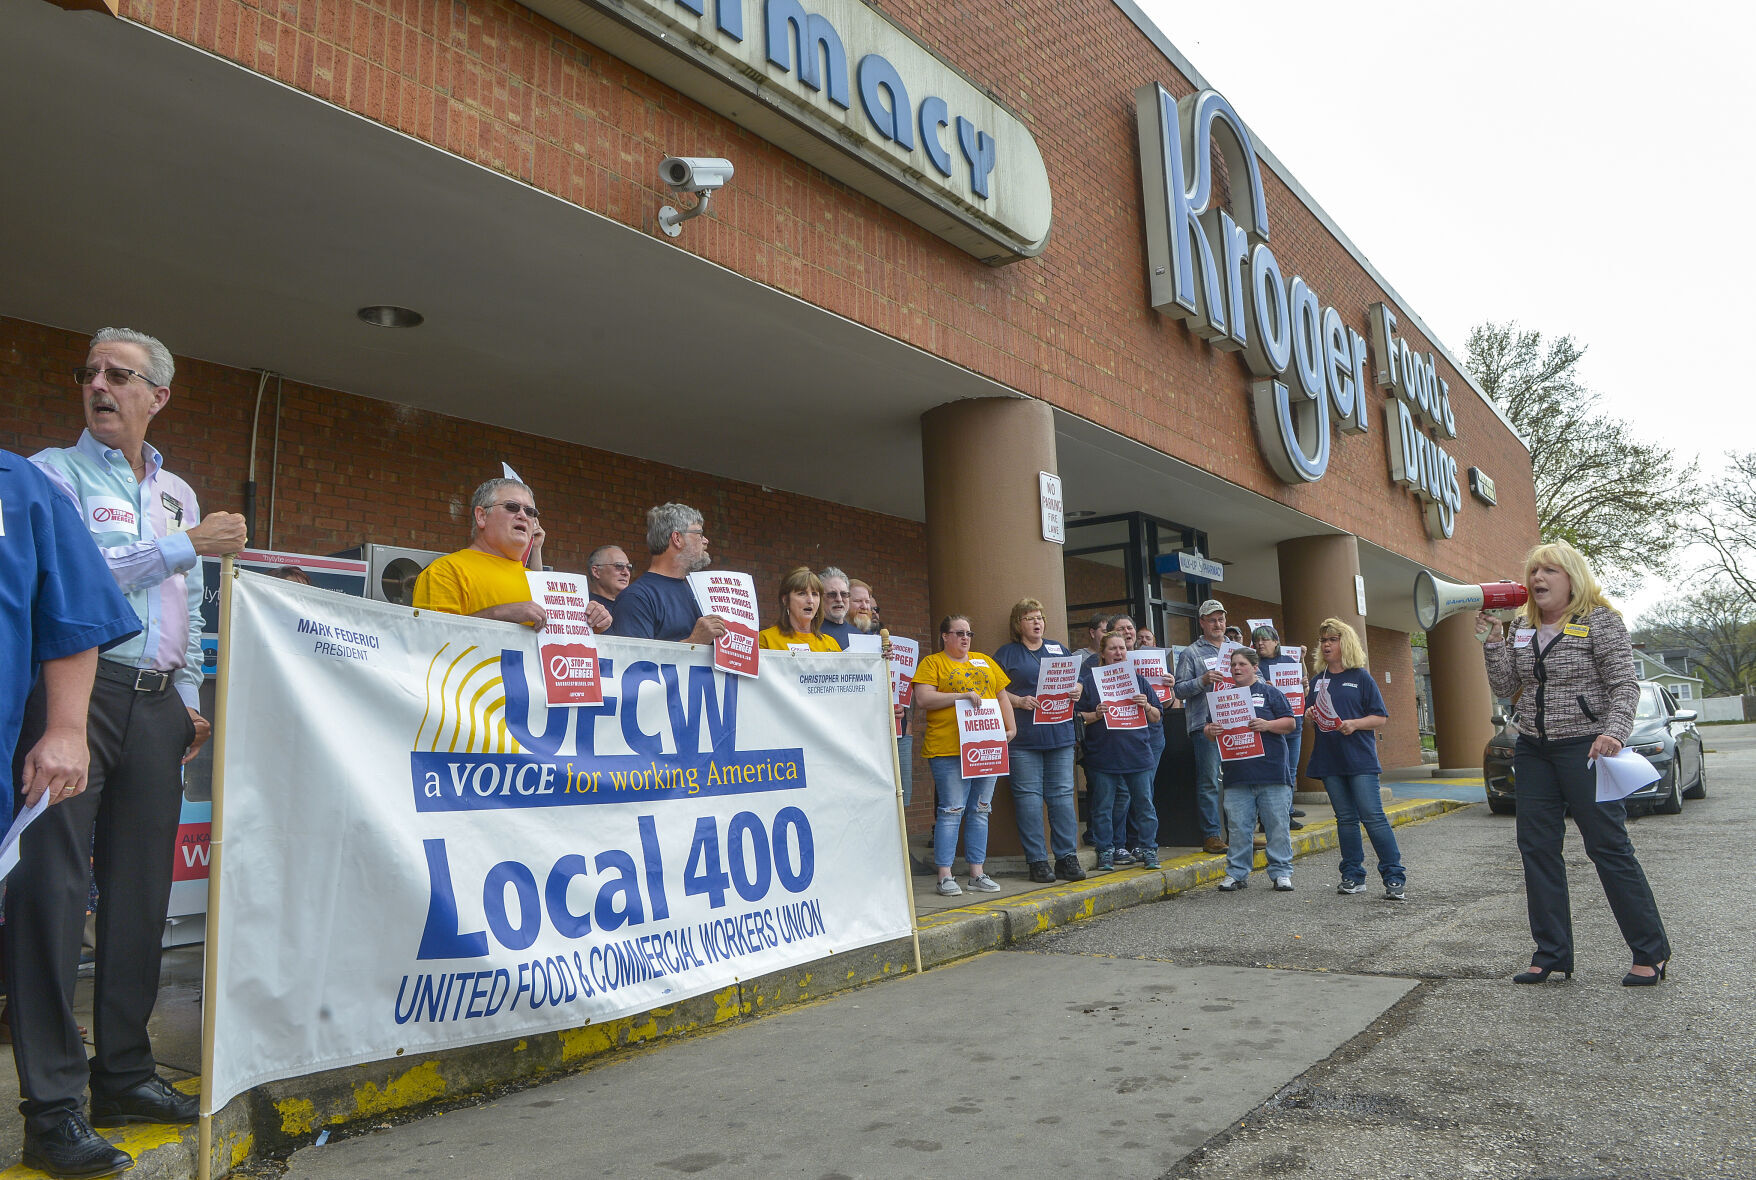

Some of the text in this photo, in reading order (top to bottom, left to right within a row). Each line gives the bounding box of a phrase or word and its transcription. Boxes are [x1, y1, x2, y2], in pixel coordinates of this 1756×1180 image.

[1137, 81, 1367, 485] Kroger
[1373, 302, 1442, 427] Food
[1388, 398, 1461, 539] Drugs
[1046, 481, 1056, 495] NO
[1043, 496, 1062, 512] PARKING
[1048, 512, 1058, 523] FIRE
[1048, 524, 1059, 534] LANE
[546, 581, 558, 592] SAY
[560, 582, 568, 592] NO
[709, 577, 722, 585] SAY
[723, 577, 733, 585] NO
[708, 586, 750, 598] HIGHER PRICES
[544, 595, 585, 608] HIGHER PRICES
[731, 597, 752, 609] CHOICES
[546, 609, 587, 622] FEWER CHOICES
[711, 605, 755, 621] STORE CLOSURES
[297, 618, 380, 650] MARK FEDERICI
[545, 623, 590, 636] STORE CLOSURES
[733, 634, 746, 644] STOP
[314, 641, 369, 661] PRESIDENT
[730, 642, 753, 655] MERGER
[571, 659, 584, 667] STOP
[570, 668, 593, 679] MERGER
[799, 673, 873, 684] CHRISTOPHER HOFFMANN
[1117, 673, 1130, 681] PRICES
[1275, 677, 1300, 687] MERGER
[807, 684, 866, 694] SECRETARY-TREASURER
[501, 648, 739, 756] UFCW
[1231, 700, 1247, 708] PRICES
[964, 707, 996, 718] NO GROCERY
[964, 718, 1001, 732] MERGER
[1230, 715, 1252, 724] CLOSURES
[424, 758, 798, 797] a VOICE for working America
[416, 806, 815, 960] Local 400
[394, 898, 826, 1025] UNITED FOOD & COMMERCIAL WORKERS UNION
